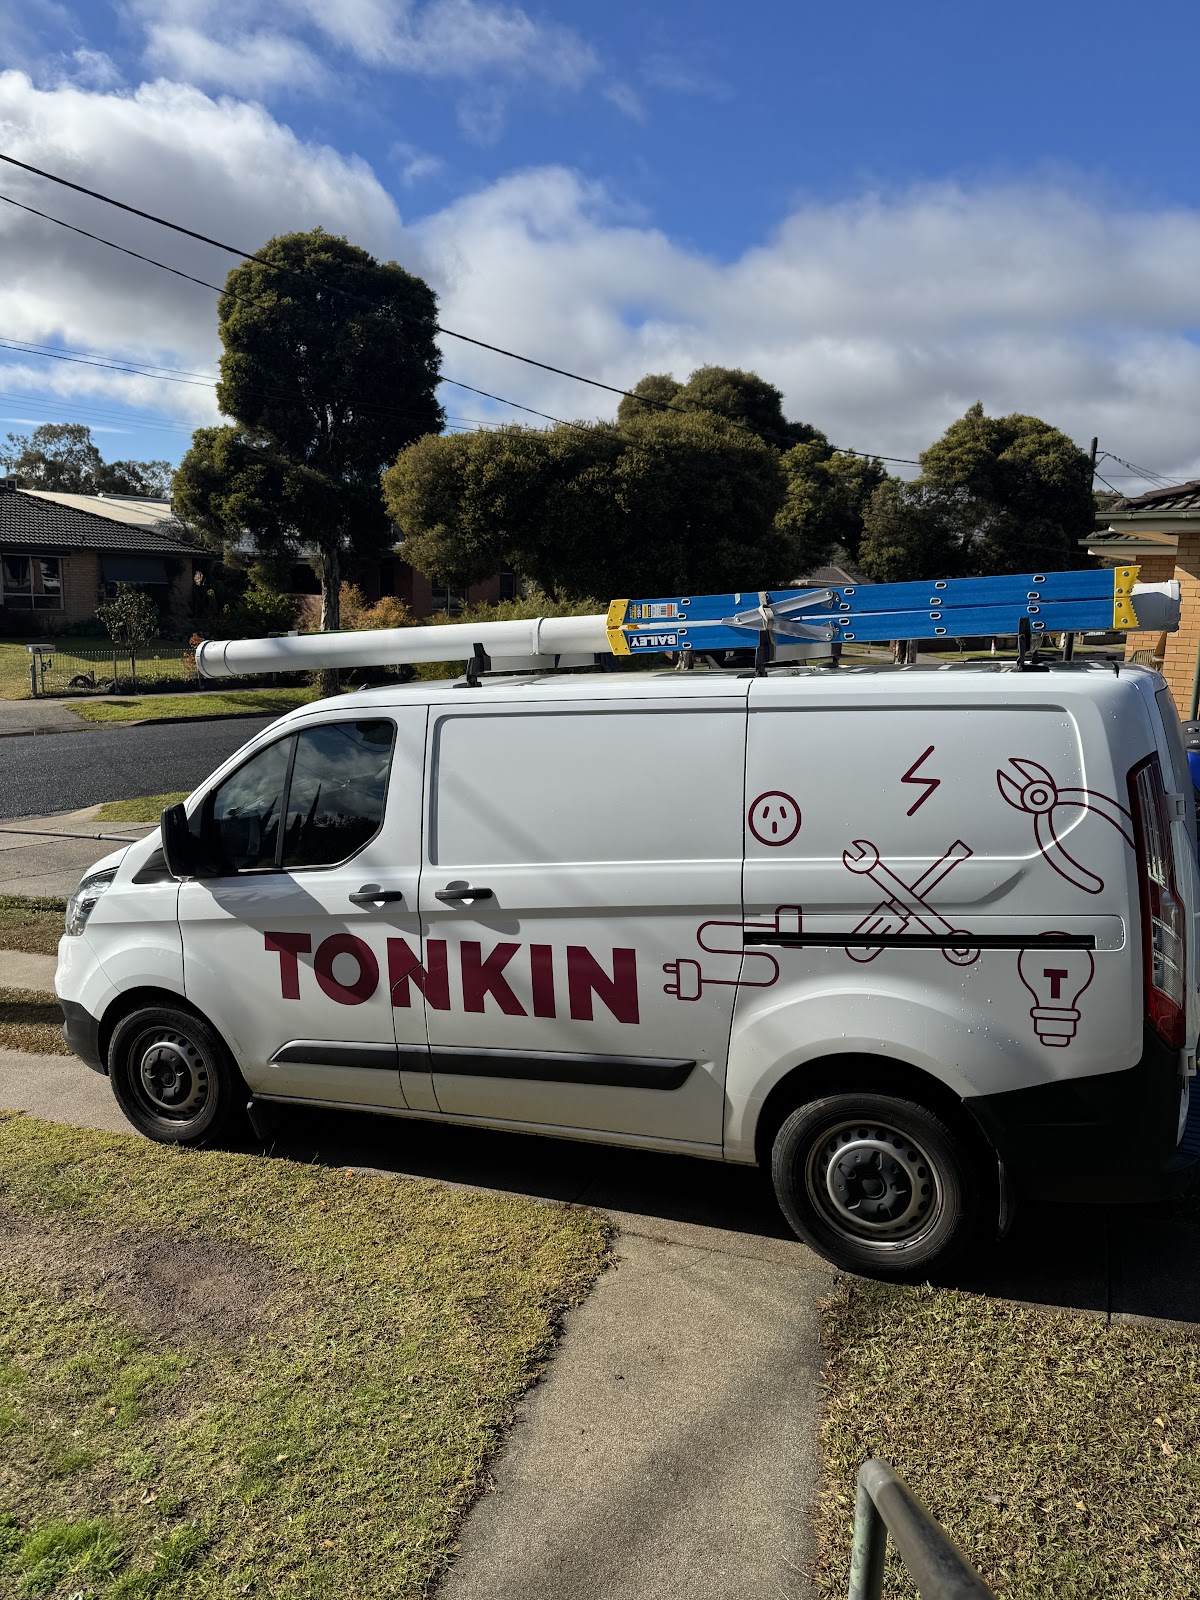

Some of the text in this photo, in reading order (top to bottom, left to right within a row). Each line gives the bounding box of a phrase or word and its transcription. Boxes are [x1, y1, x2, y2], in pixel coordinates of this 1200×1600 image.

[631, 635, 676, 647] BAILEY
[264, 931, 640, 1024] TONKIN
[1043, 968, 1068, 999] T
